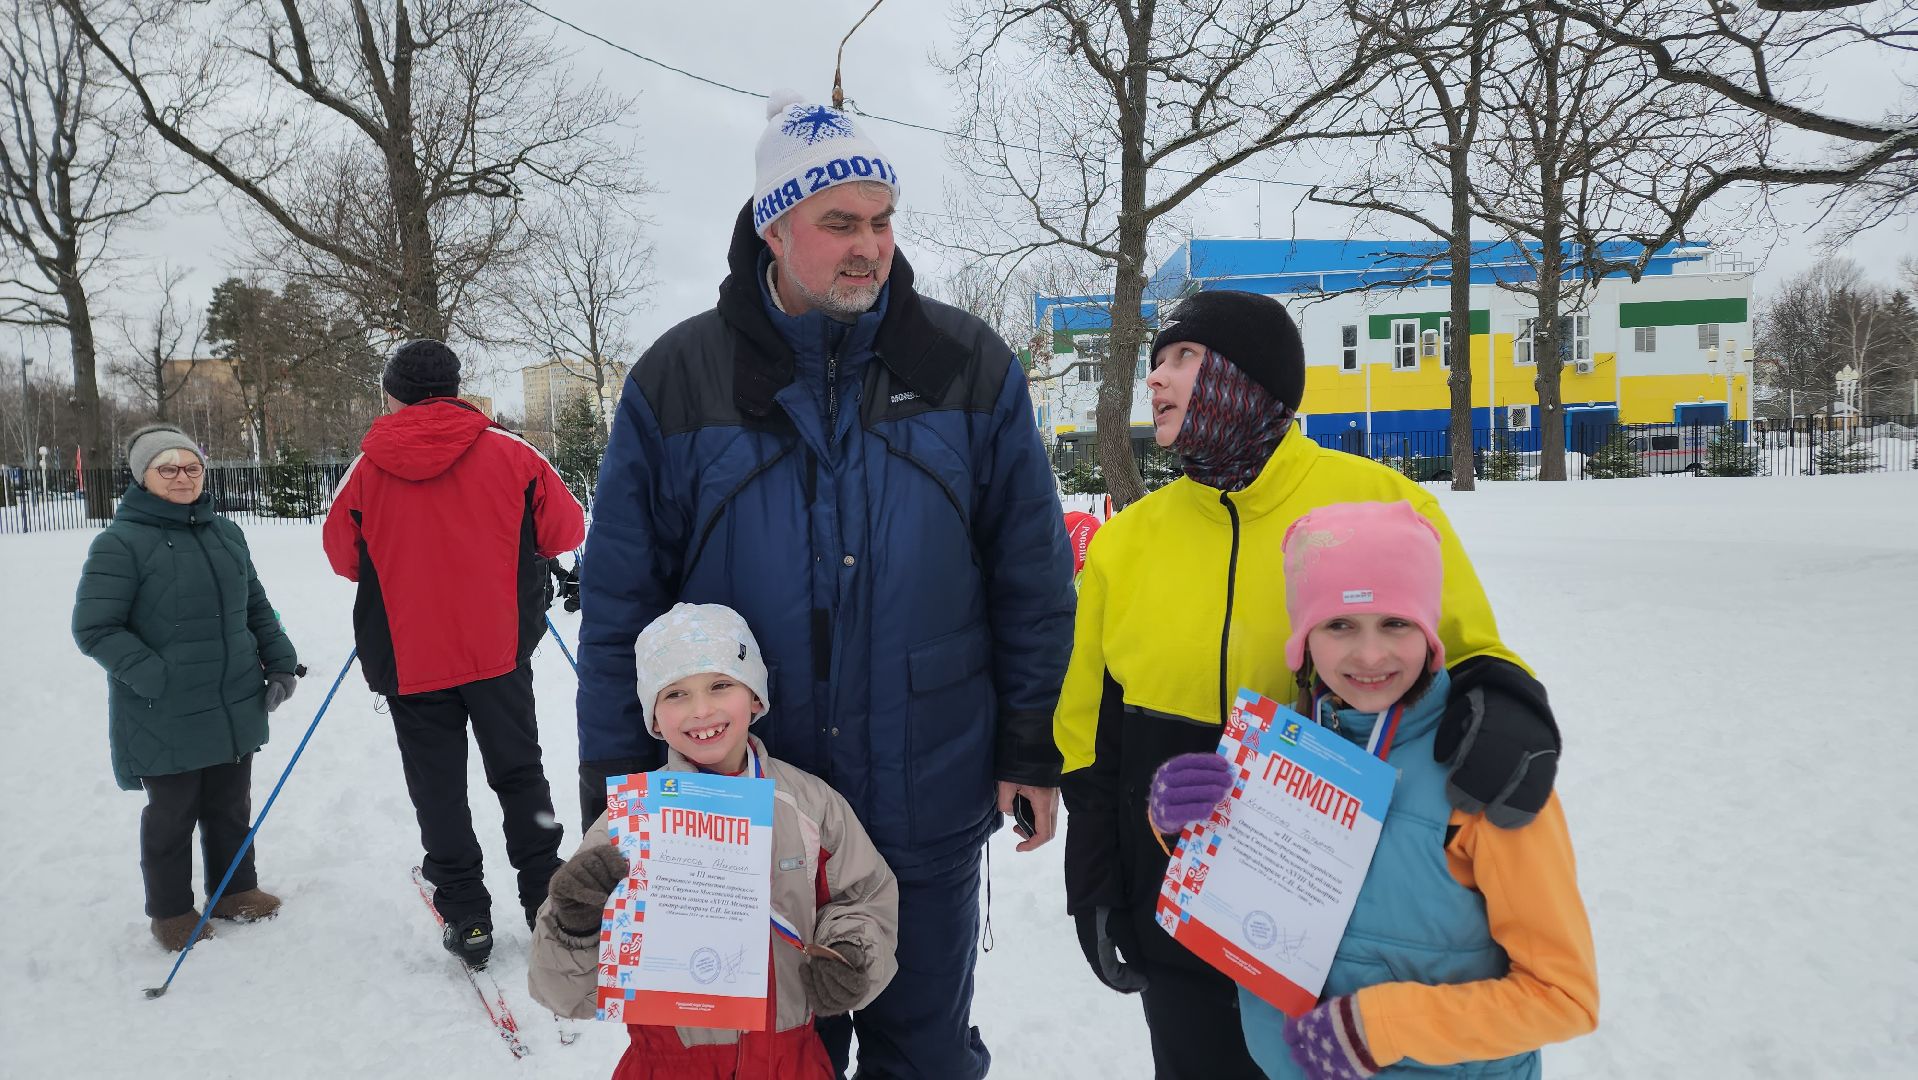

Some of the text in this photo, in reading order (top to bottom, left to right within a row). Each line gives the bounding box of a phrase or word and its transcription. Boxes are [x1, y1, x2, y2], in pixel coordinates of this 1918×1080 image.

[804, 155, 887, 193] 2001
[1262, 753, 1361, 831] ГРАМОТА
[661, 808, 749, 846] ГРАМОТА
